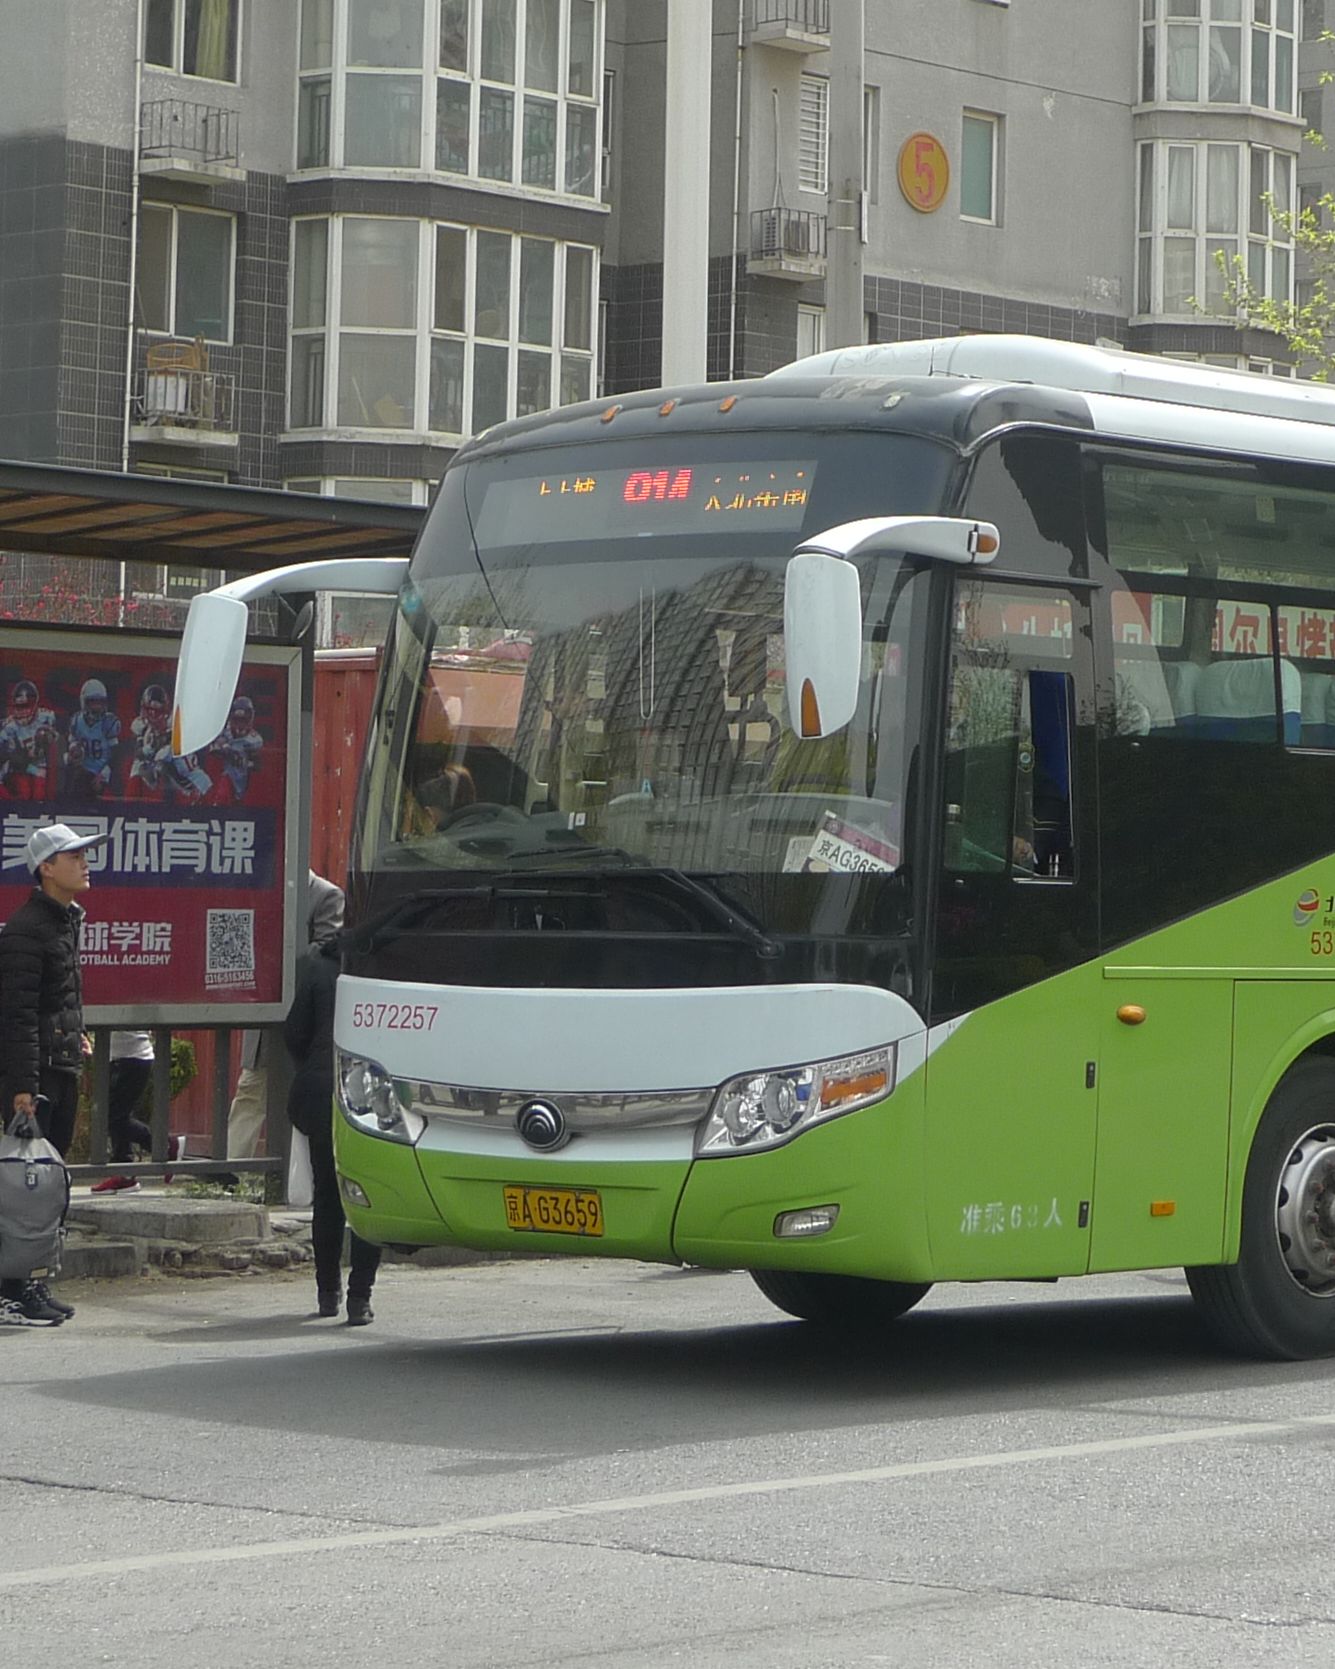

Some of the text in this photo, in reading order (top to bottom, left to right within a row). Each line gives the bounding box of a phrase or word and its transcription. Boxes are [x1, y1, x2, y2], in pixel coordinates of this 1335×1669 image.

[914, 141, 936, 205] 5
[121, 954, 171, 965] ACADEMY
[353, 1003, 438, 1031] 5372257
